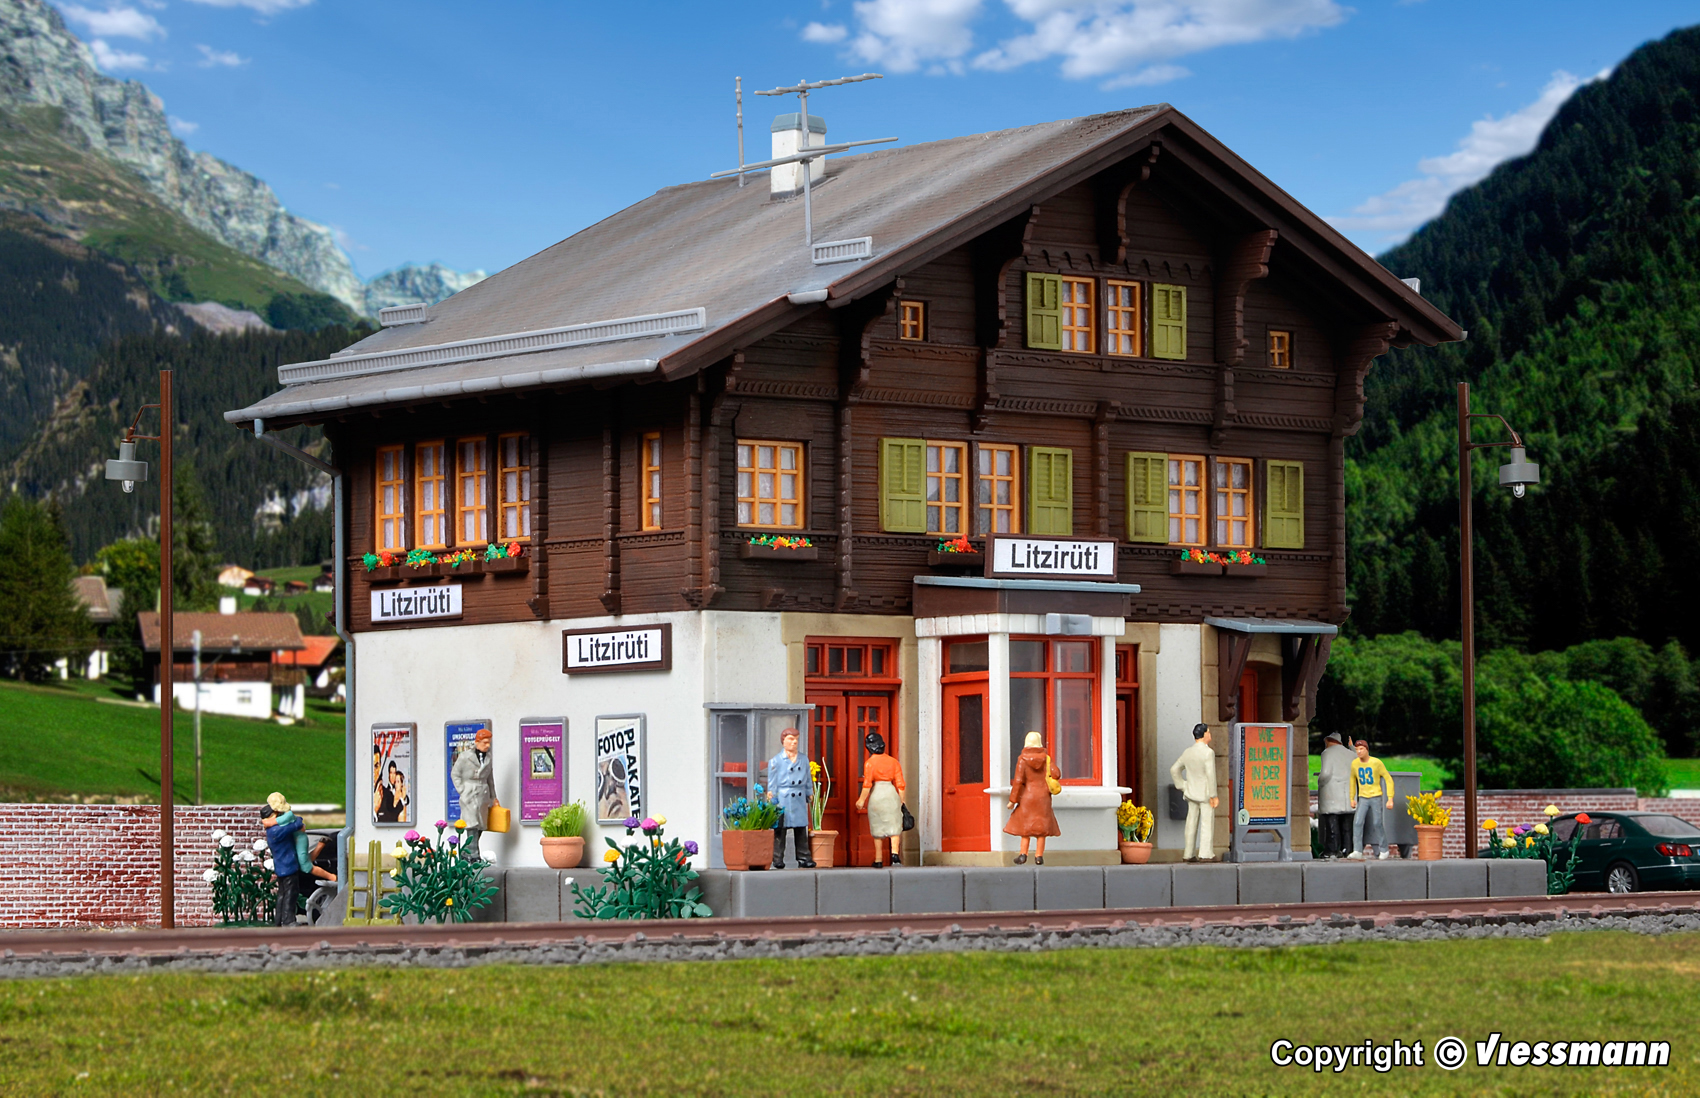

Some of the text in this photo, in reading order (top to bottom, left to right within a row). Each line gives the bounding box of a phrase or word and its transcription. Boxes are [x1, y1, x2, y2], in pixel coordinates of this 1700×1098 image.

[1011, 543, 1098, 570] Litzirüti
[380, 588, 451, 617] Litzirüti
[578, 633, 649, 663] Litzirüti
[598, 731, 624, 756] FOTO
[1258, 728, 1275, 743] WIE
[1248, 746, 1284, 762] BLUMEN
[624, 728, 641, 819] PLAKATE
[1251, 765, 1280, 781] IN DER
[1358, 767, 1374, 785] 93
[1251, 782, 1280, 800] WÜSTE
